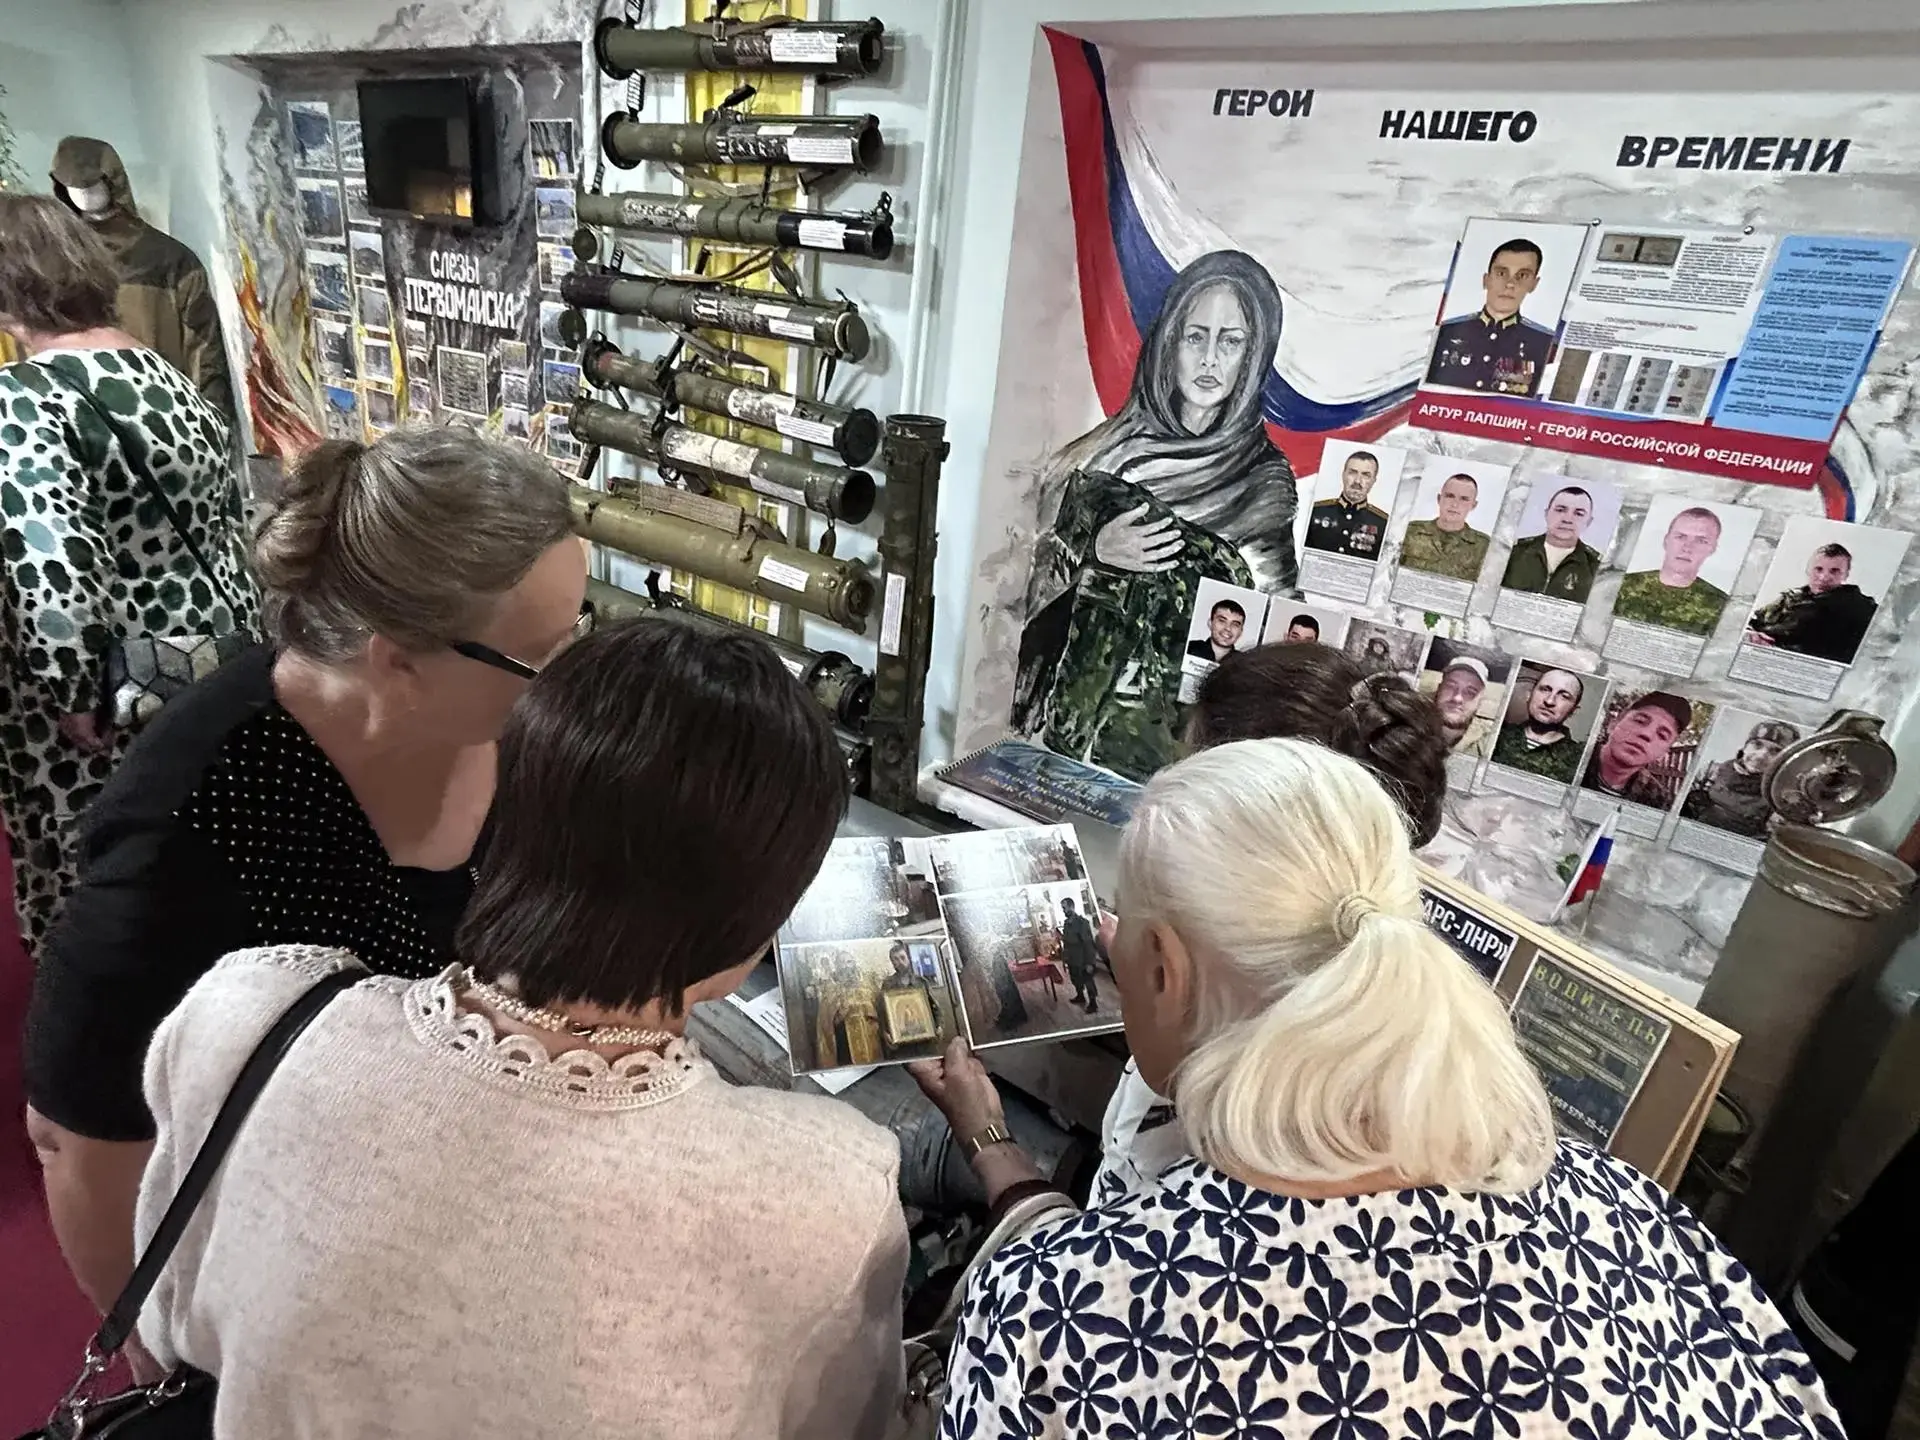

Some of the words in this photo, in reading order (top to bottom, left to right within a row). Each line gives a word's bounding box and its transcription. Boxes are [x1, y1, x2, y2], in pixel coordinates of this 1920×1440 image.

[1212, 89, 1315, 117] ГЕРОИ
[1379, 110, 1538, 143] НАШЕГО
[1616, 135, 1852, 173] ВРЕМЕНИ
[1418, 403, 1463, 420] АРТУР
[1463, 409, 1528, 431] ЛАПШИН
[1538, 421, 1588, 441] ГЕРОЙ
[1589, 431, 1701, 459] РОССИЙСКОЙ
[1703, 448, 1813, 476] ФЕДЕРАЦИИ
[1422, 897, 1508, 961] АРС-ЛНР»
